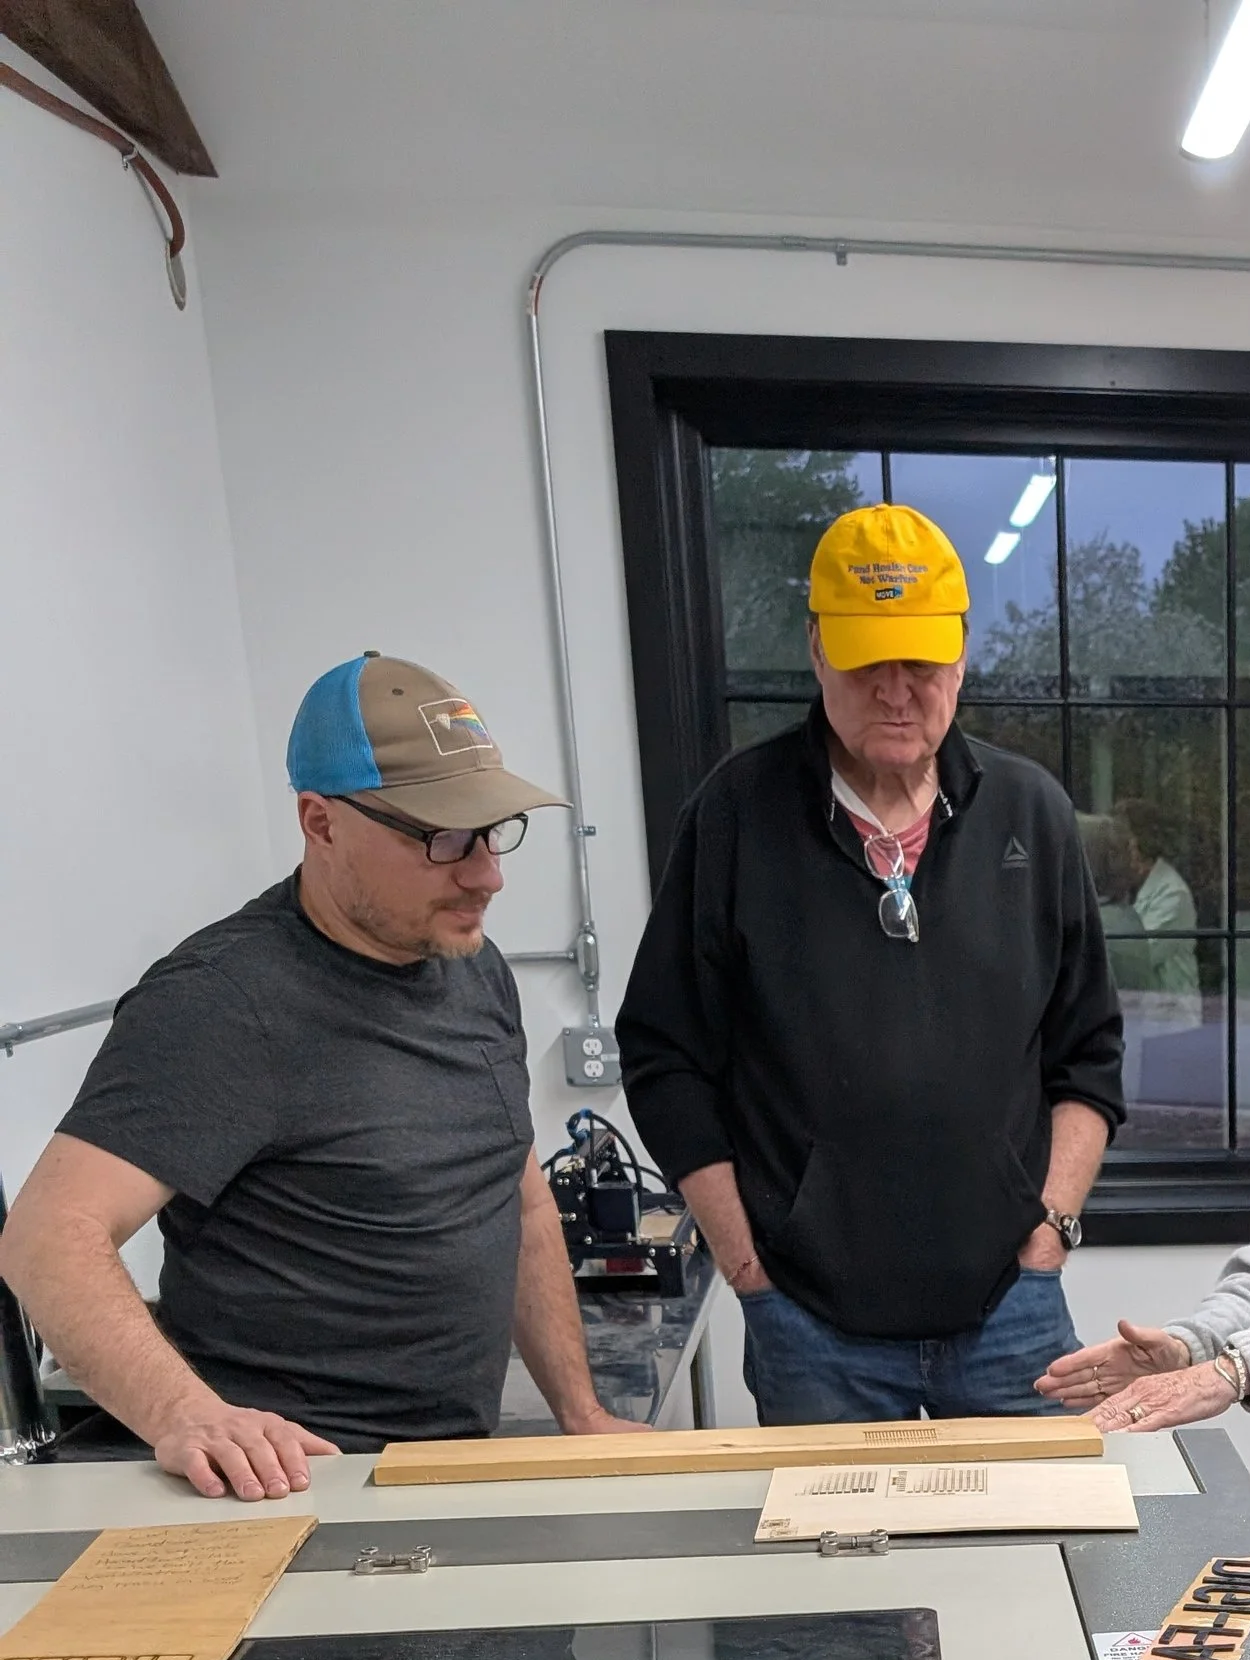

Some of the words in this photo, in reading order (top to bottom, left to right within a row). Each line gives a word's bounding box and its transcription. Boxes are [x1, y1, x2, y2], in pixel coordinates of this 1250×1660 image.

[848, 564, 870, 574] Fund
[872, 562, 905, 573] Health
[907, 564, 929, 573] Care
